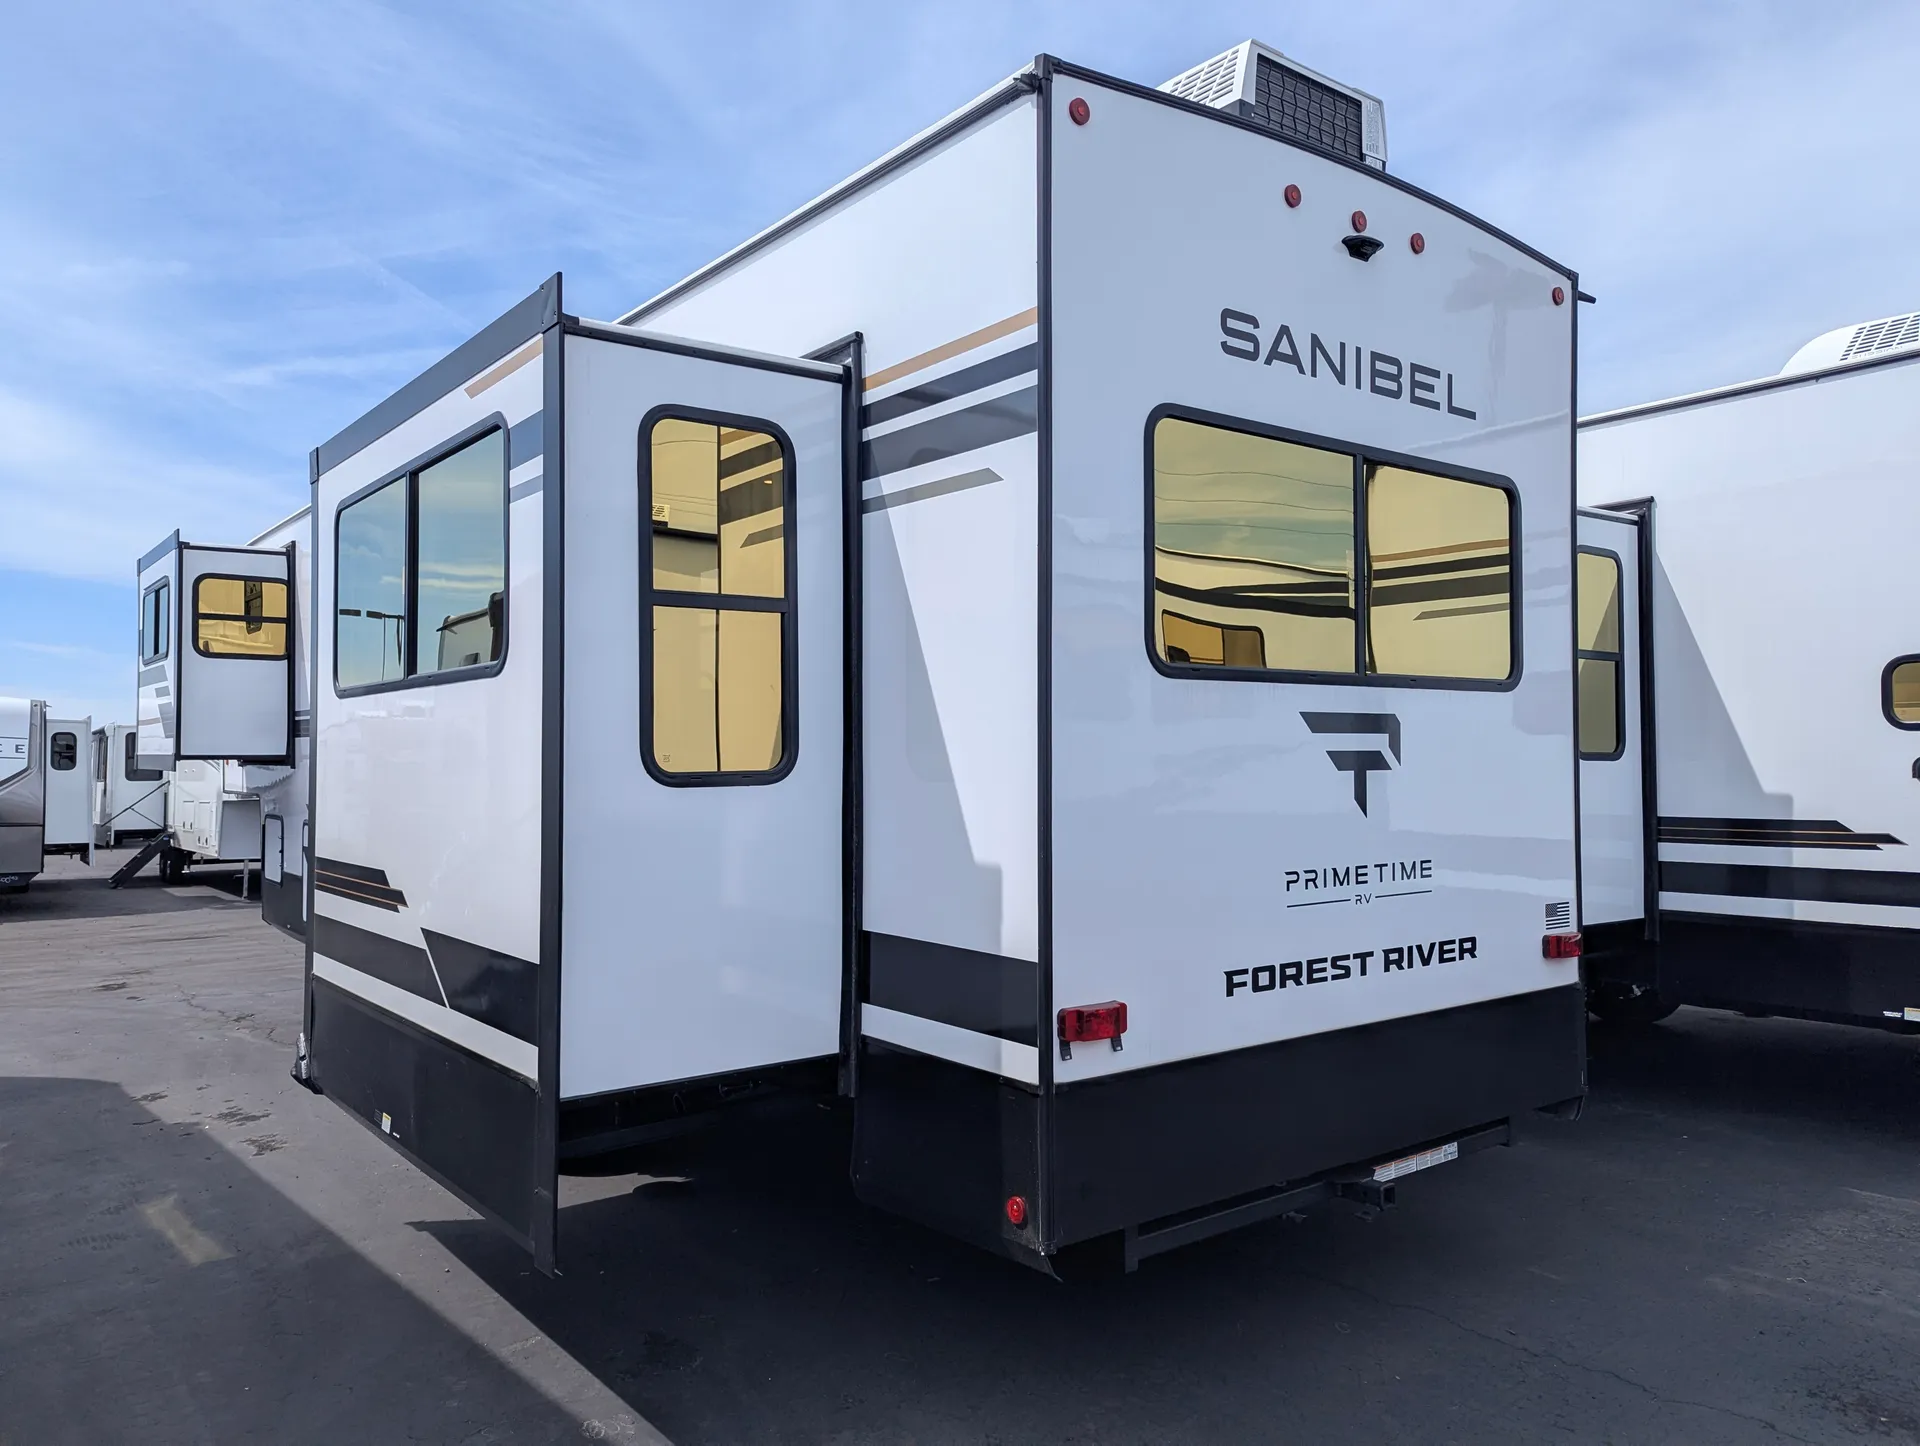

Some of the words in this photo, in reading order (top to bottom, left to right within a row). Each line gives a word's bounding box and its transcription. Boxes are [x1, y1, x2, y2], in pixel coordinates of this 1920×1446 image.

[1220, 307, 1477, 421] SANIBEL
[1354, 892, 1373, 906] RV
[1223, 950, 1375, 998] FOREST
[1381, 935, 1478, 974] RIVER
